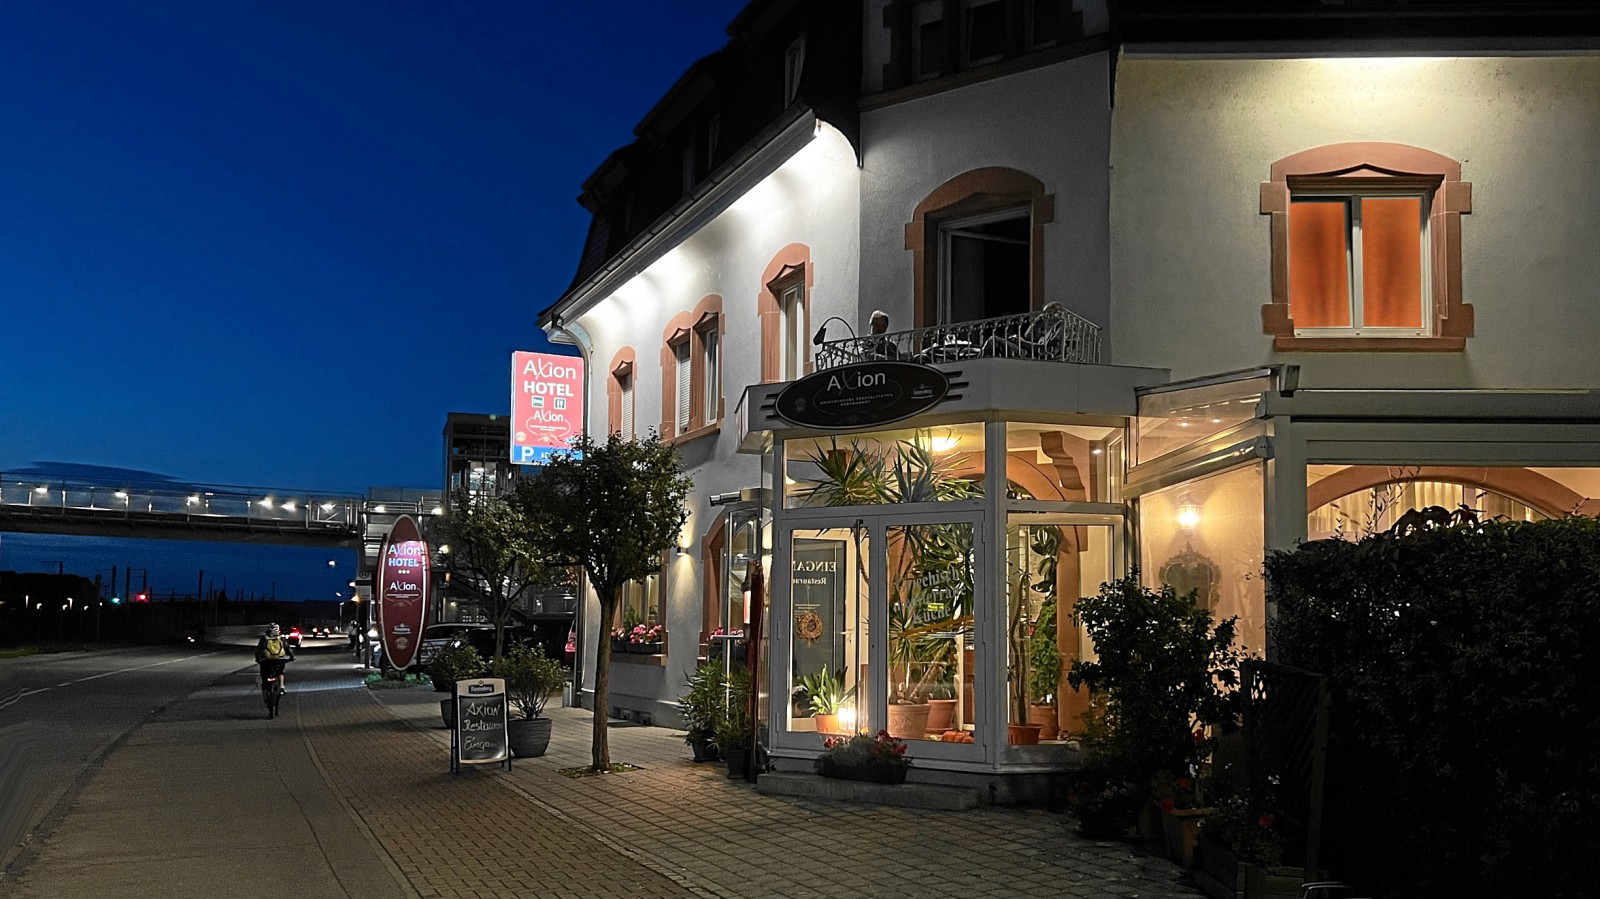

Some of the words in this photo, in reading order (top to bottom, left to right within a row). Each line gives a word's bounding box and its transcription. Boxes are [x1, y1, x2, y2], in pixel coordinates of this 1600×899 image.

[523, 380, 574, 397] HOTEL
[521, 446, 534, 462] P
[388, 558, 419, 567] HOTEL
